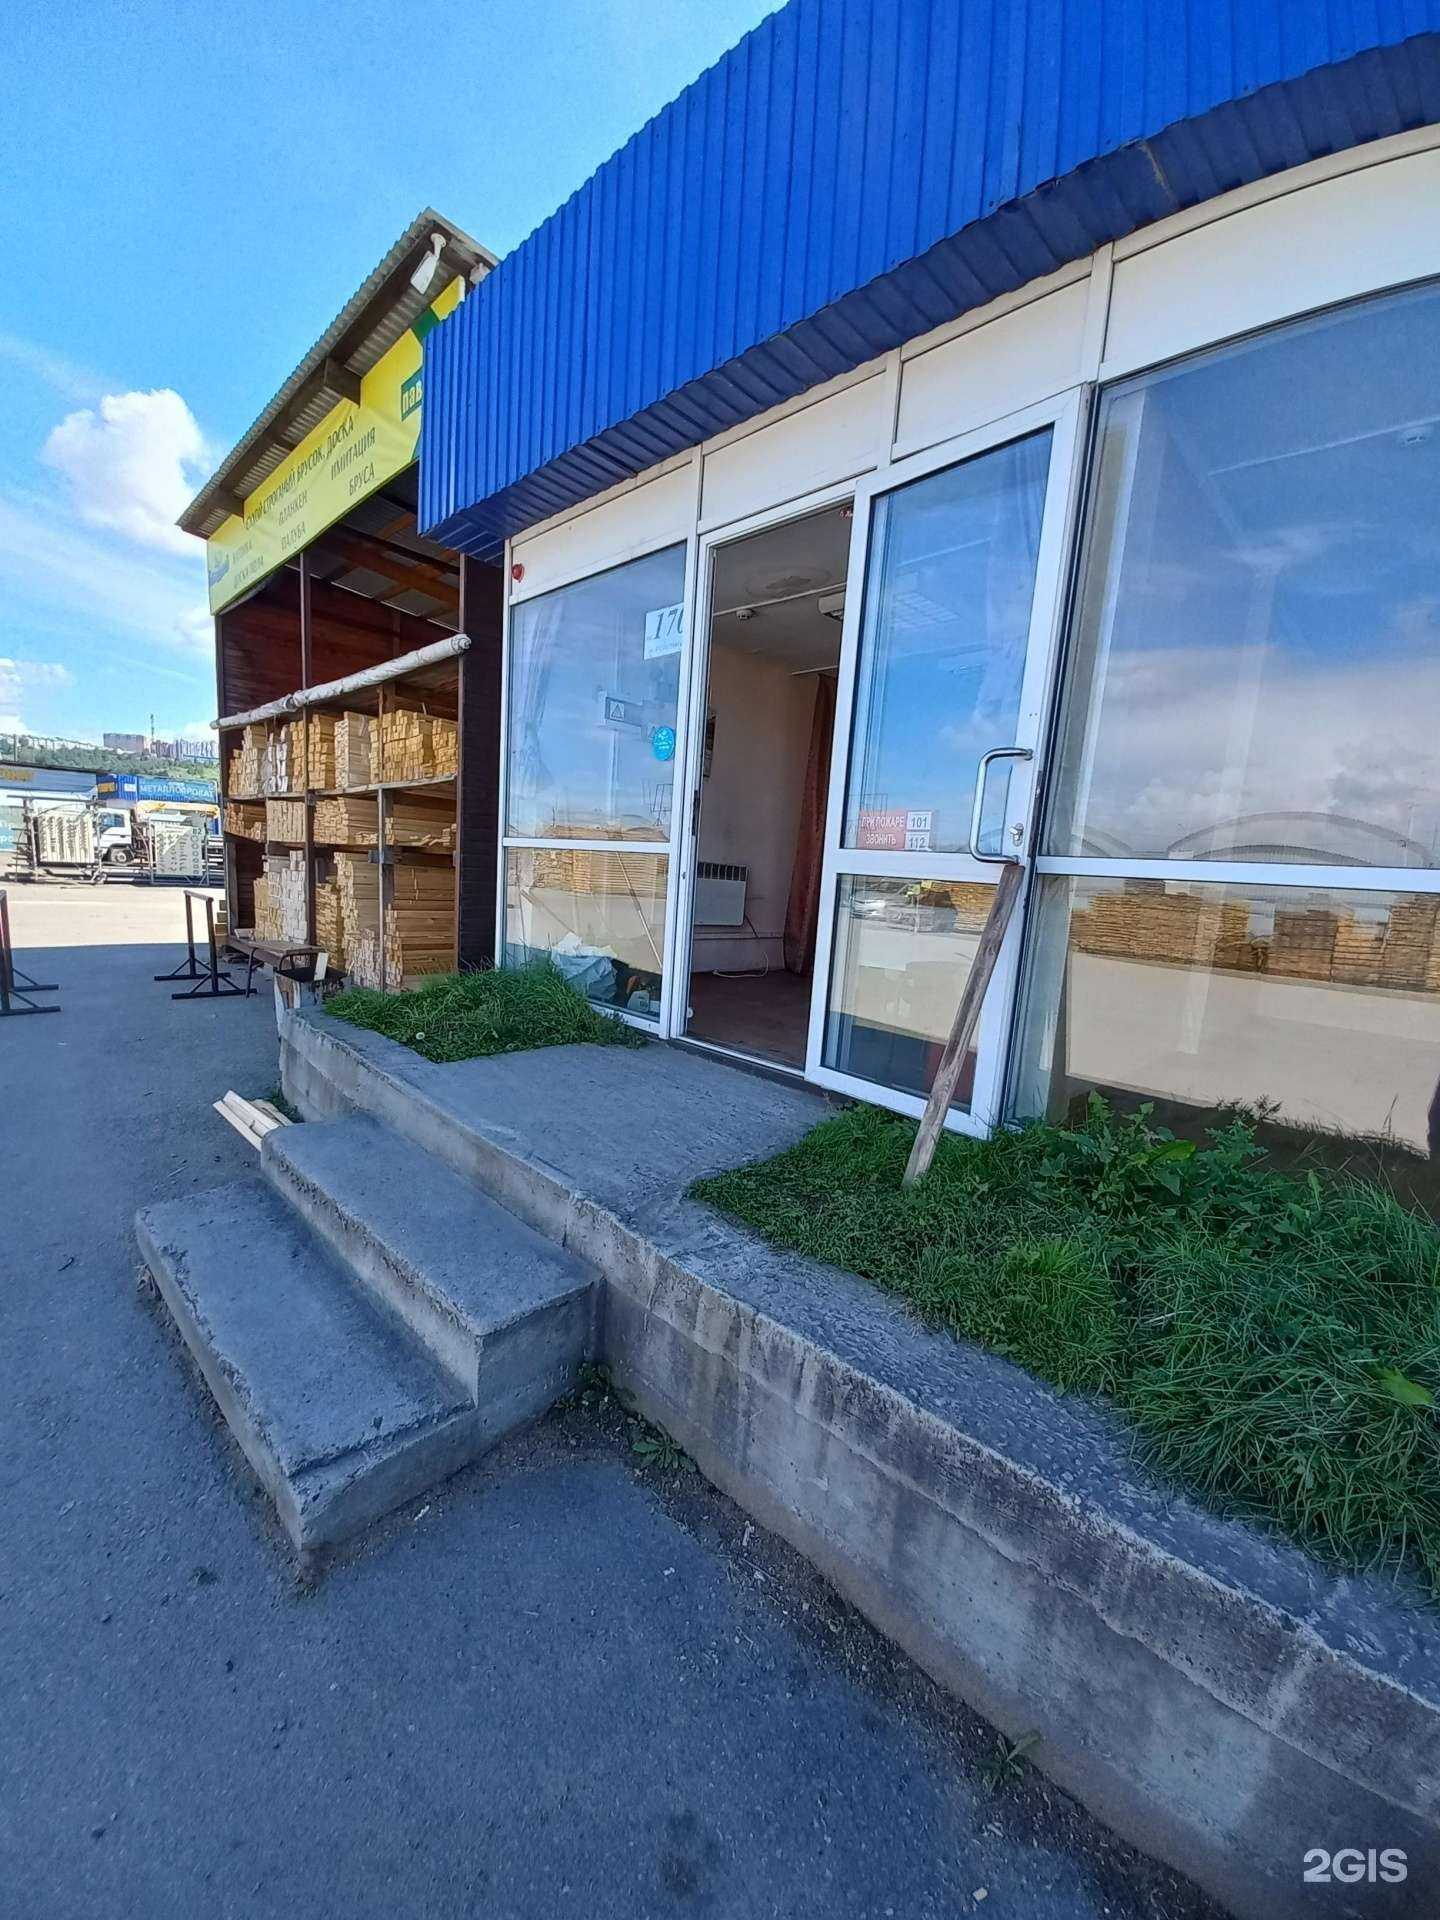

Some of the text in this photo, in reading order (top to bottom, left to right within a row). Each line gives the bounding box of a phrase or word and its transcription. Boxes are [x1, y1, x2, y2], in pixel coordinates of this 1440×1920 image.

[326, 416, 354, 460] ДОСКА
[331, 427, 376, 480] ИМИТАЦИЯ
[349, 462, 375, 496] БРУСА
[875, 816, 905, 828] ПОЖАРЕ
[911, 816, 928, 828] 101
[865, 833, 897, 845] ЗВОНИТЬ
[909, 837, 927, 849] 112
